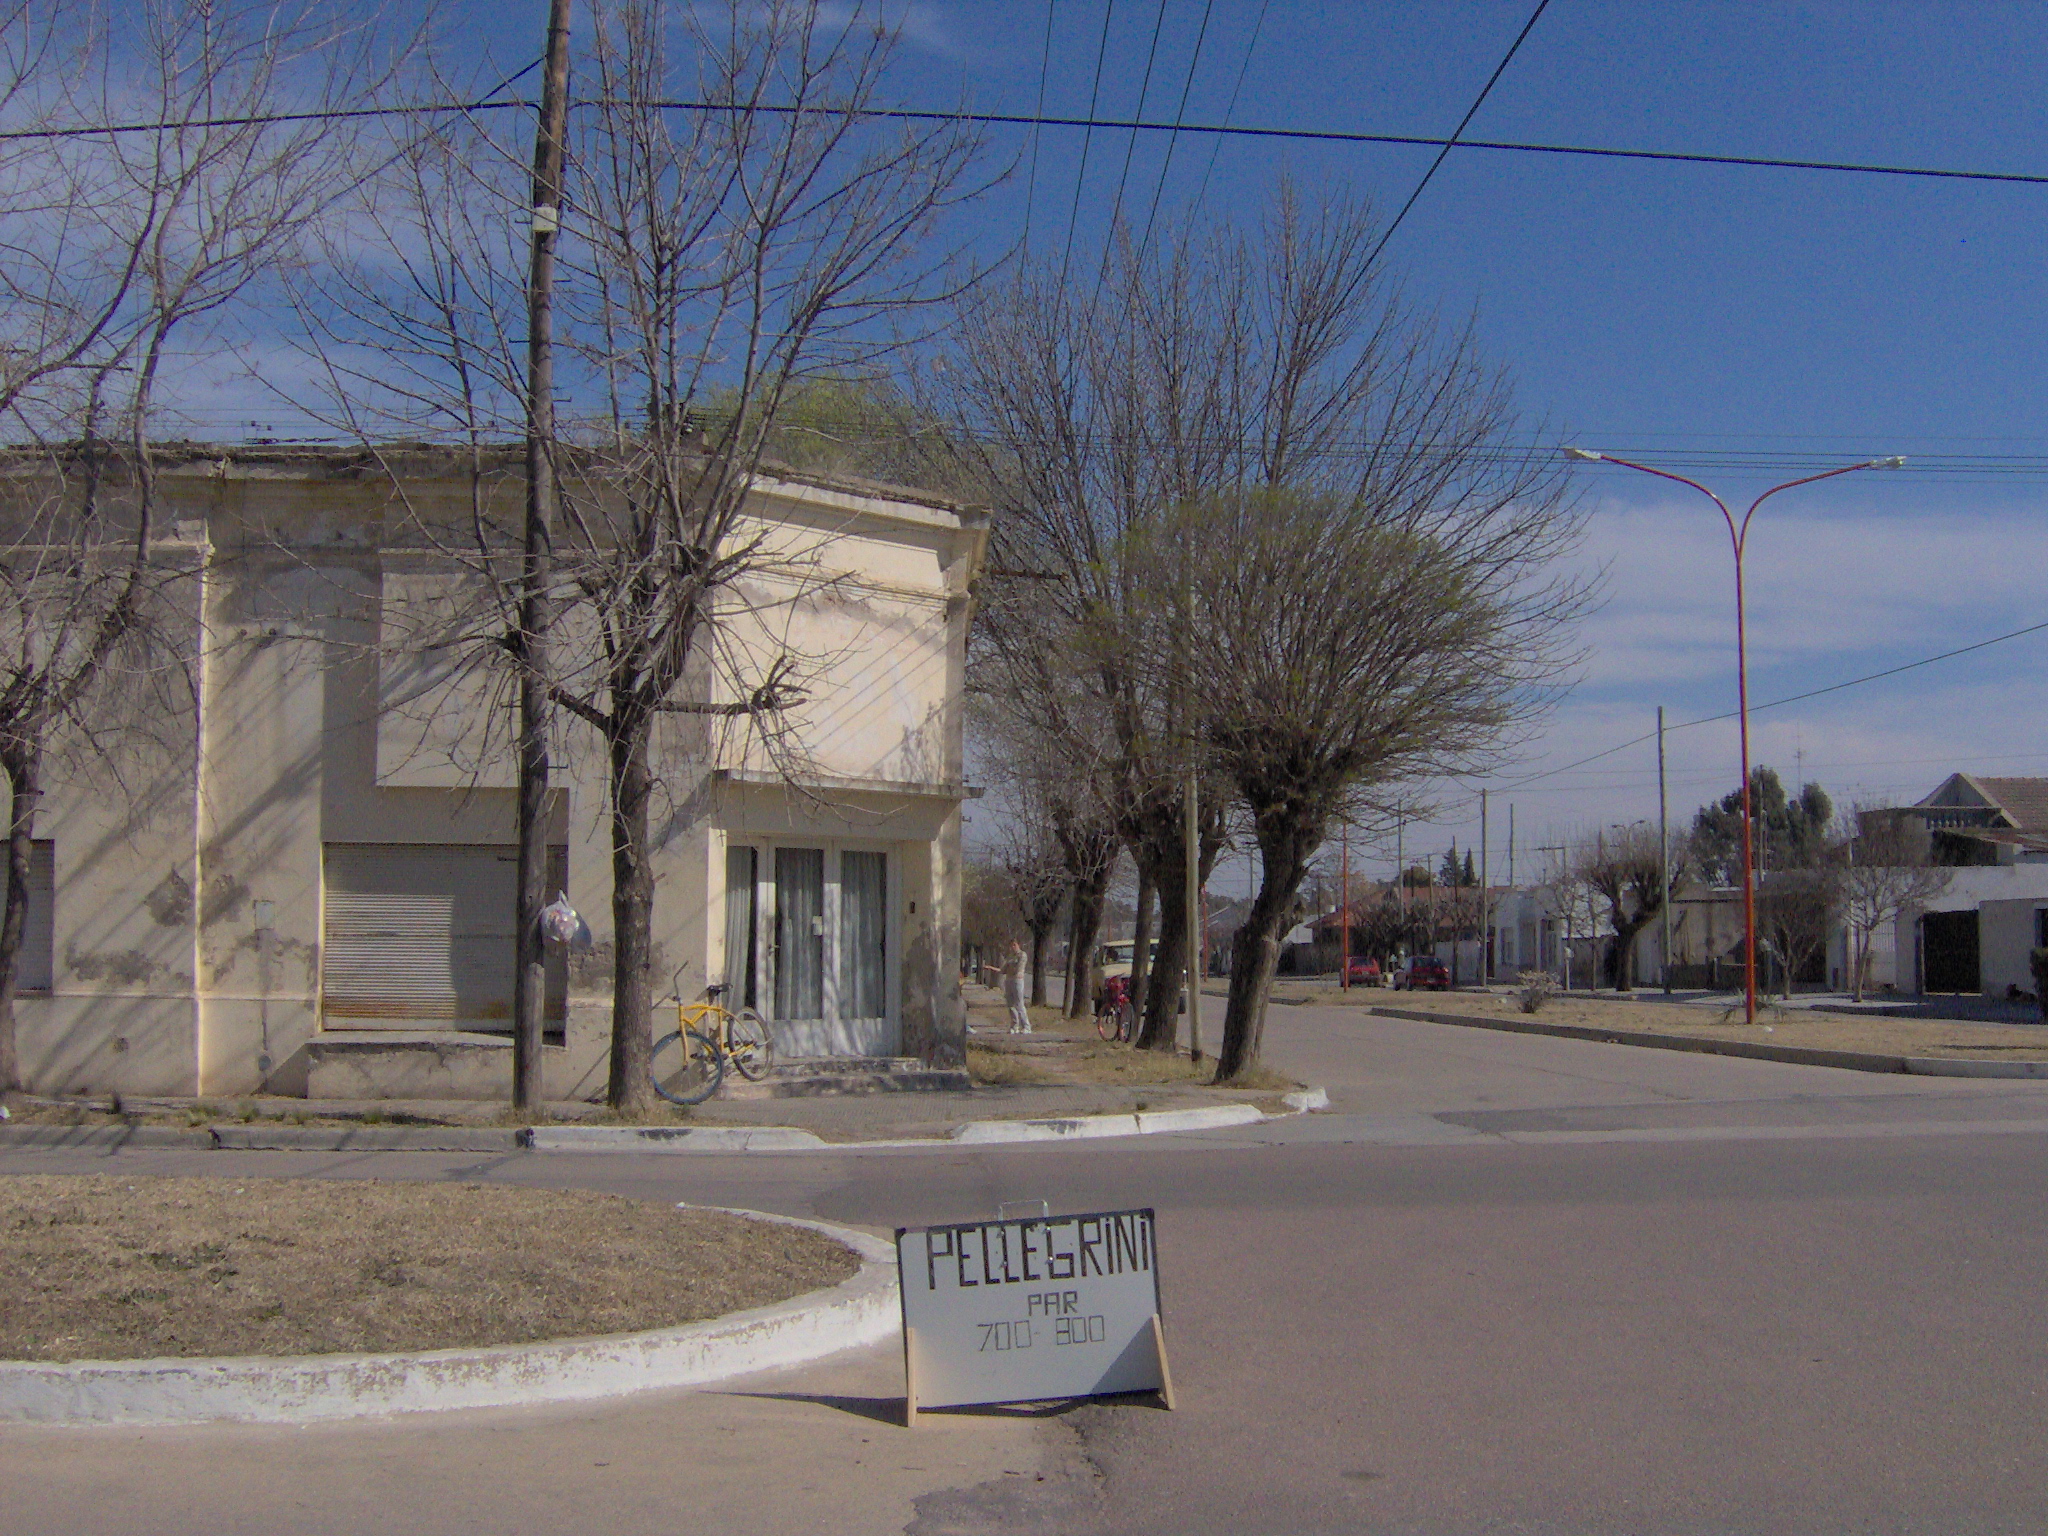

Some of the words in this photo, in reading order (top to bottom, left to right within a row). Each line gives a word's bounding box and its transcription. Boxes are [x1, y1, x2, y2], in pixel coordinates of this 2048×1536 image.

[1028, 1291, 1078, 1316] PAR
[977, 1320, 1032, 1352] 700
[1056, 1315, 1104, 1346] 800
